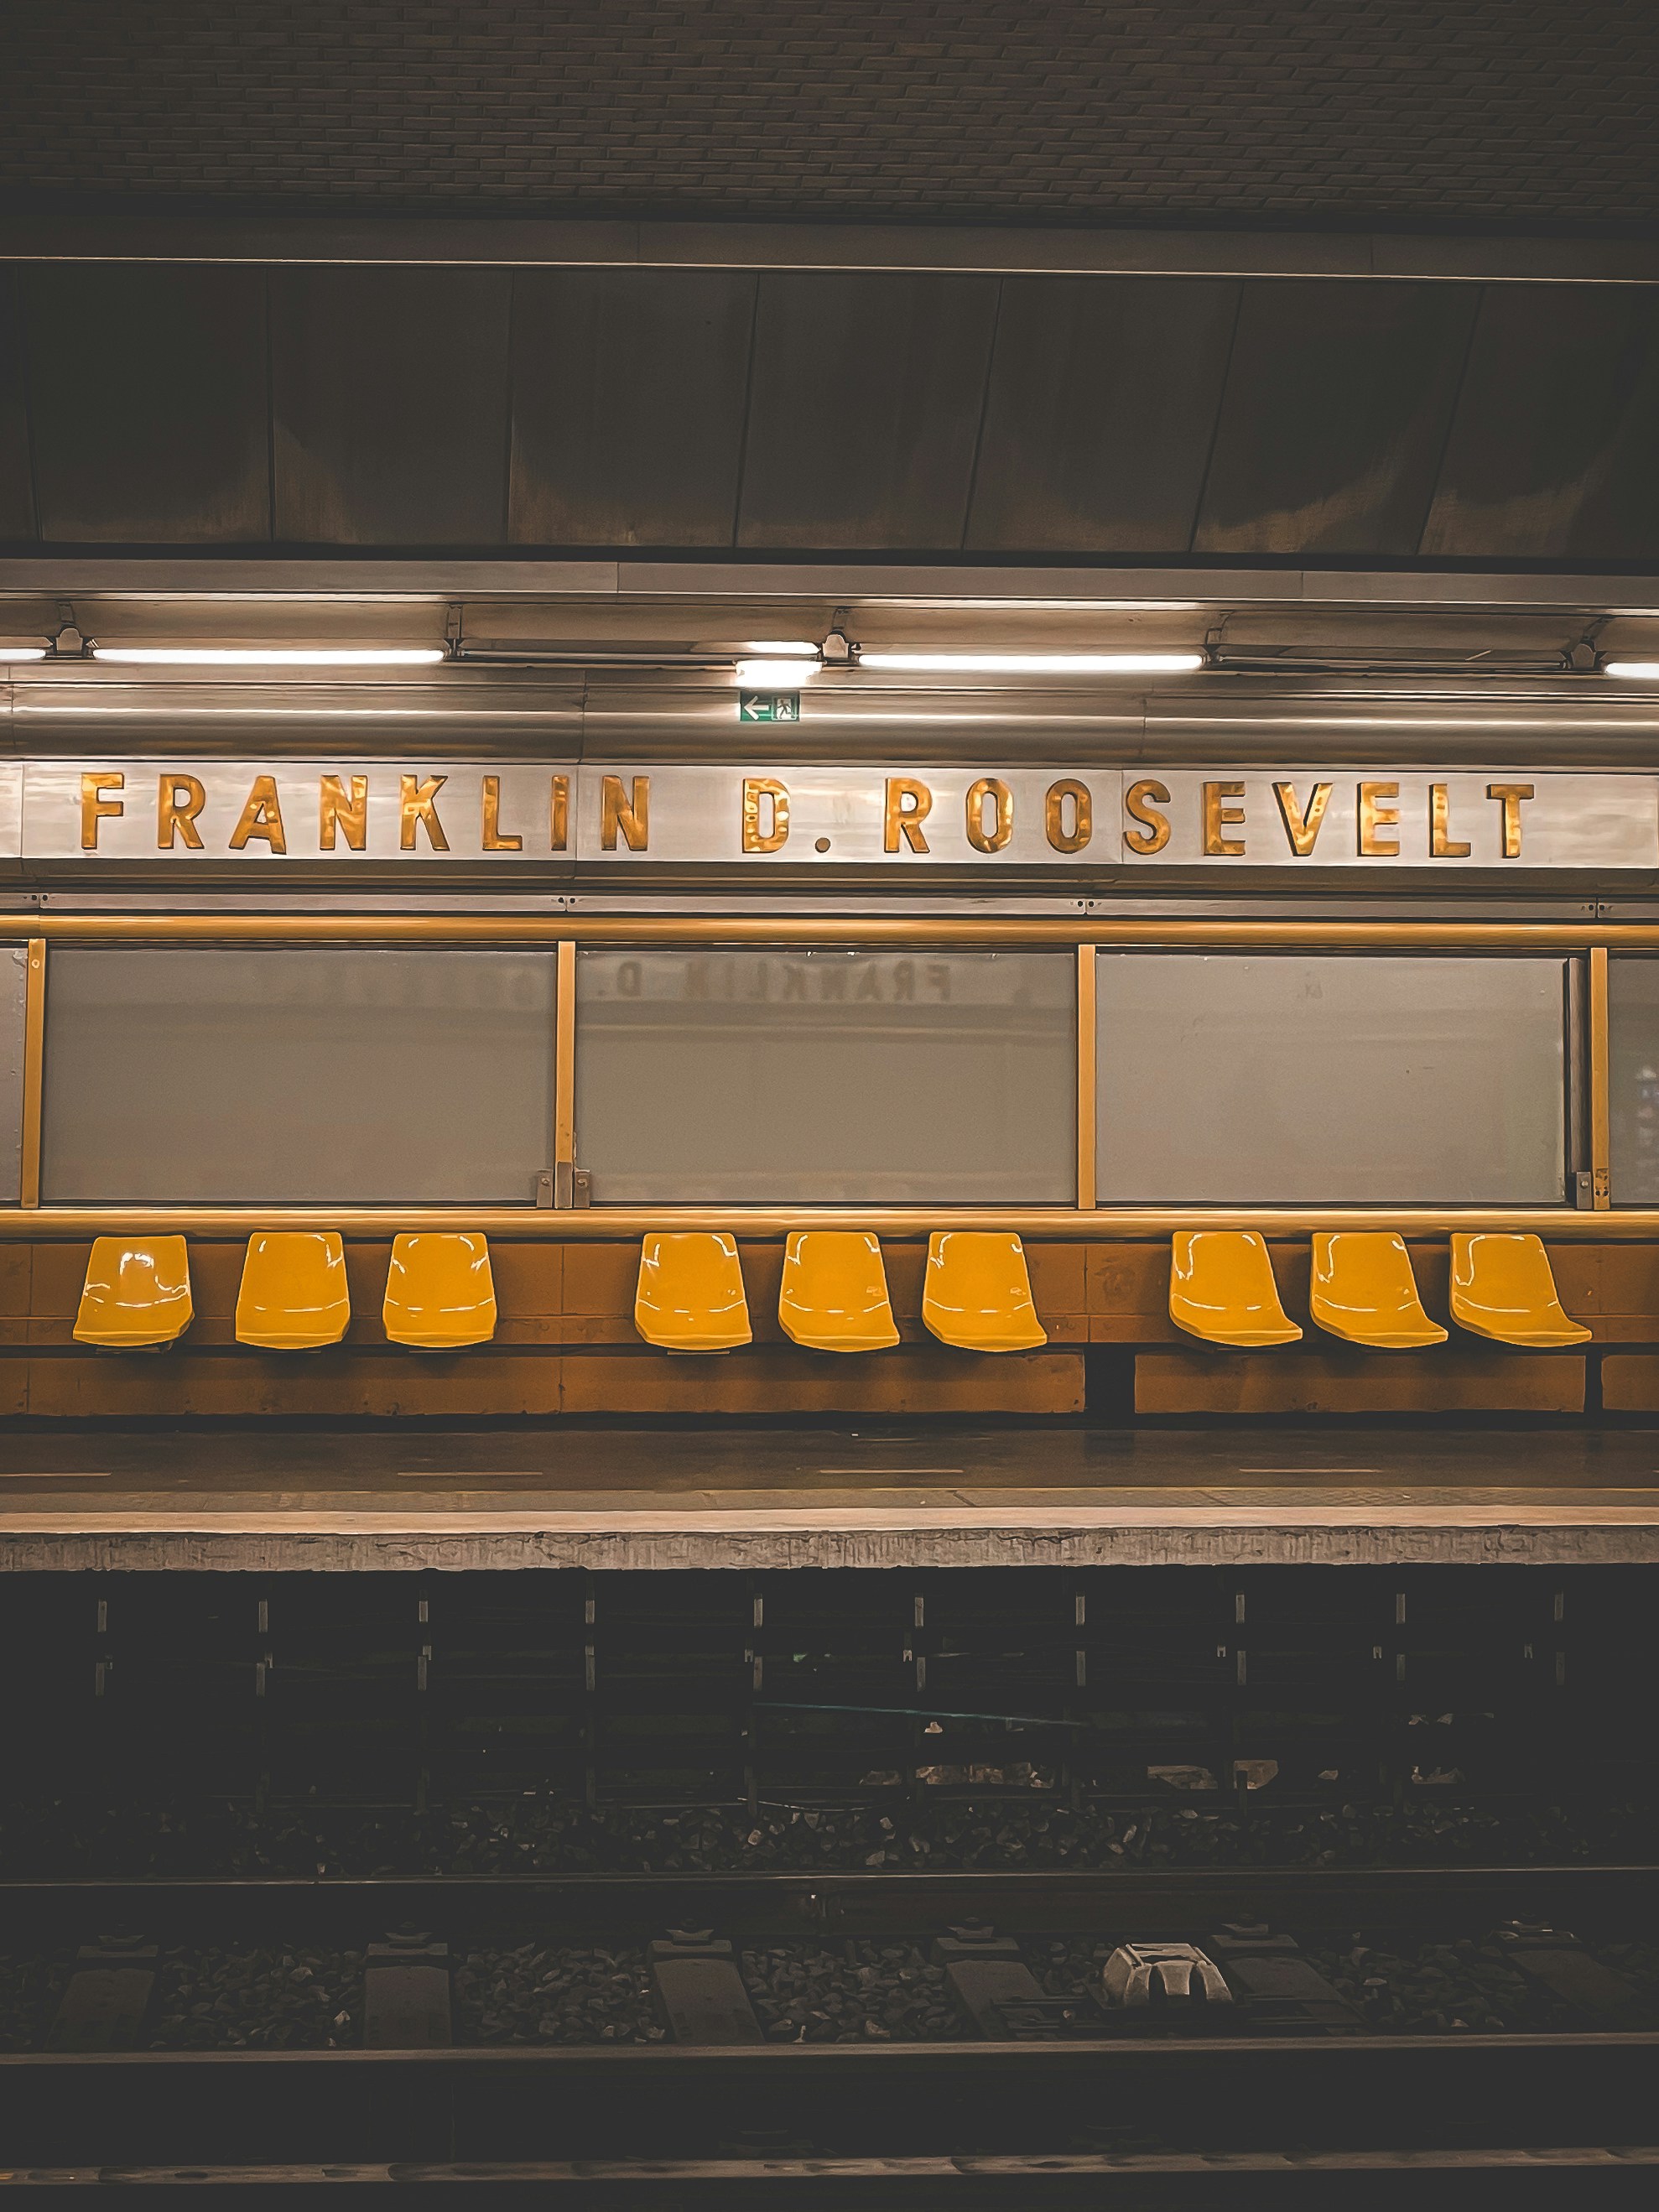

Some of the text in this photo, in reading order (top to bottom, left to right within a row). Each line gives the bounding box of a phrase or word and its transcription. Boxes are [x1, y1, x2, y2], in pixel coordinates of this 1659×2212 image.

[81, 772, 1535, 859] FRANKLIN D. ROOSEVELT
